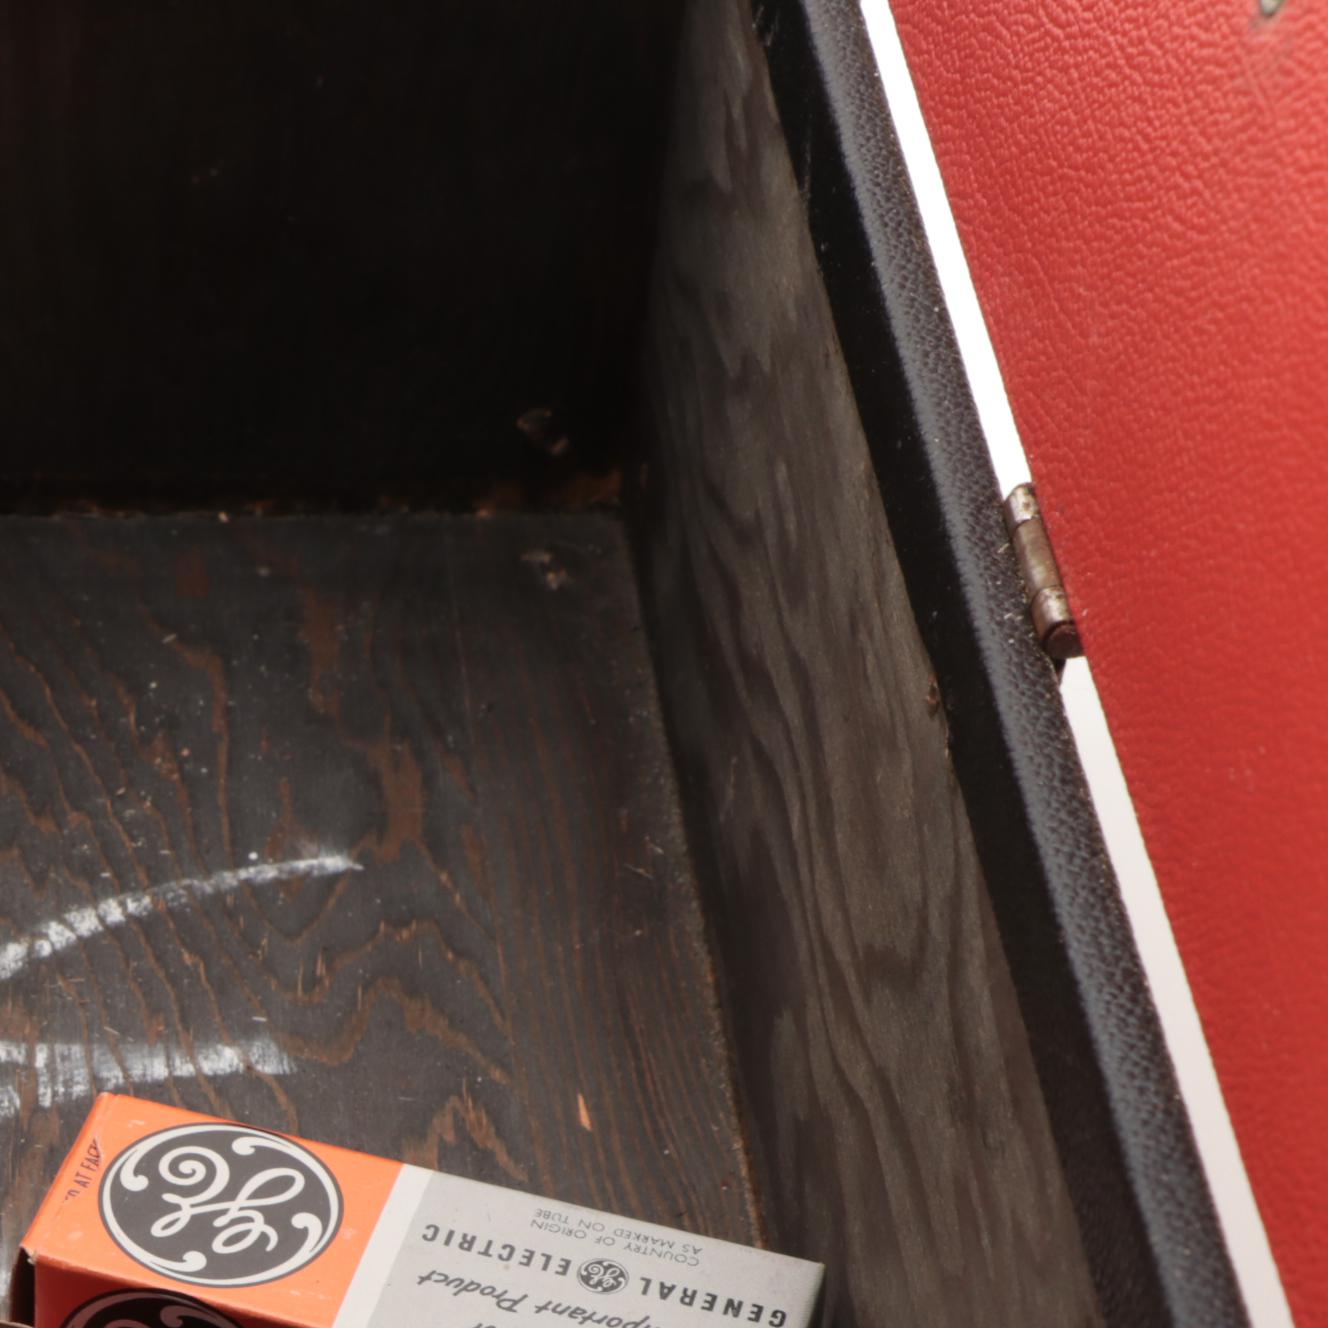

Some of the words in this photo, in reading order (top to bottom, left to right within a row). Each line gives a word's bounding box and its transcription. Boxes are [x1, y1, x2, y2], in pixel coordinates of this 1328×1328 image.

[534, 1208, 570, 1225] TUBE
[577, 1219, 606, 1233] ON
[530, 1219, 587, 1240] ORIGIN
[594, 1231, 616, 1247] OF
[613, 1228, 676, 1249] MARKED
[421, 1222, 572, 1277] ELECTRIC
[623, 1242, 700, 1267] COUNTRY
[682, 1243, 704, 1255] AS
[417, 1270, 521, 1313] Product
[640, 1276, 788, 1328] GENERAL
